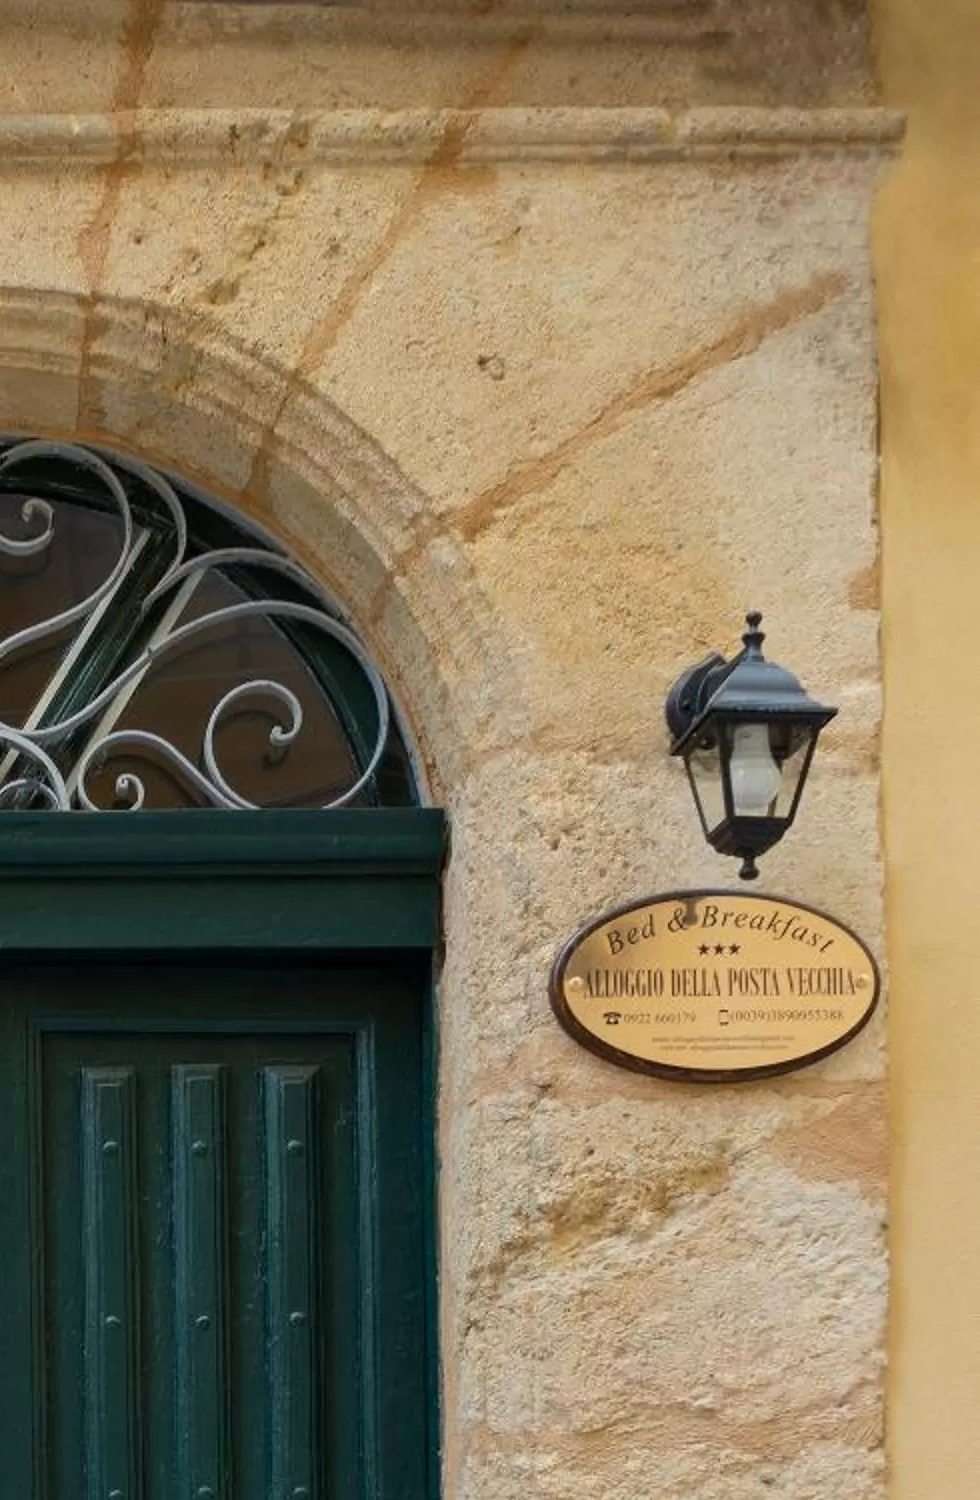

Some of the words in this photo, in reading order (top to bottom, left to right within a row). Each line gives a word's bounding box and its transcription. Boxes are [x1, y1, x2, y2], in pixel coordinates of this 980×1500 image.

[607, 913, 656, 956] Bed
[667, 907, 689, 933] &
[701, 904, 835, 953] Breakfast
[584, 968, 664, 998] ALLOGGIO
[671, 968, 721, 997] DELLA
[727, 967, 780, 997] POSTA
[786, 967, 856, 997] VECCHIA
